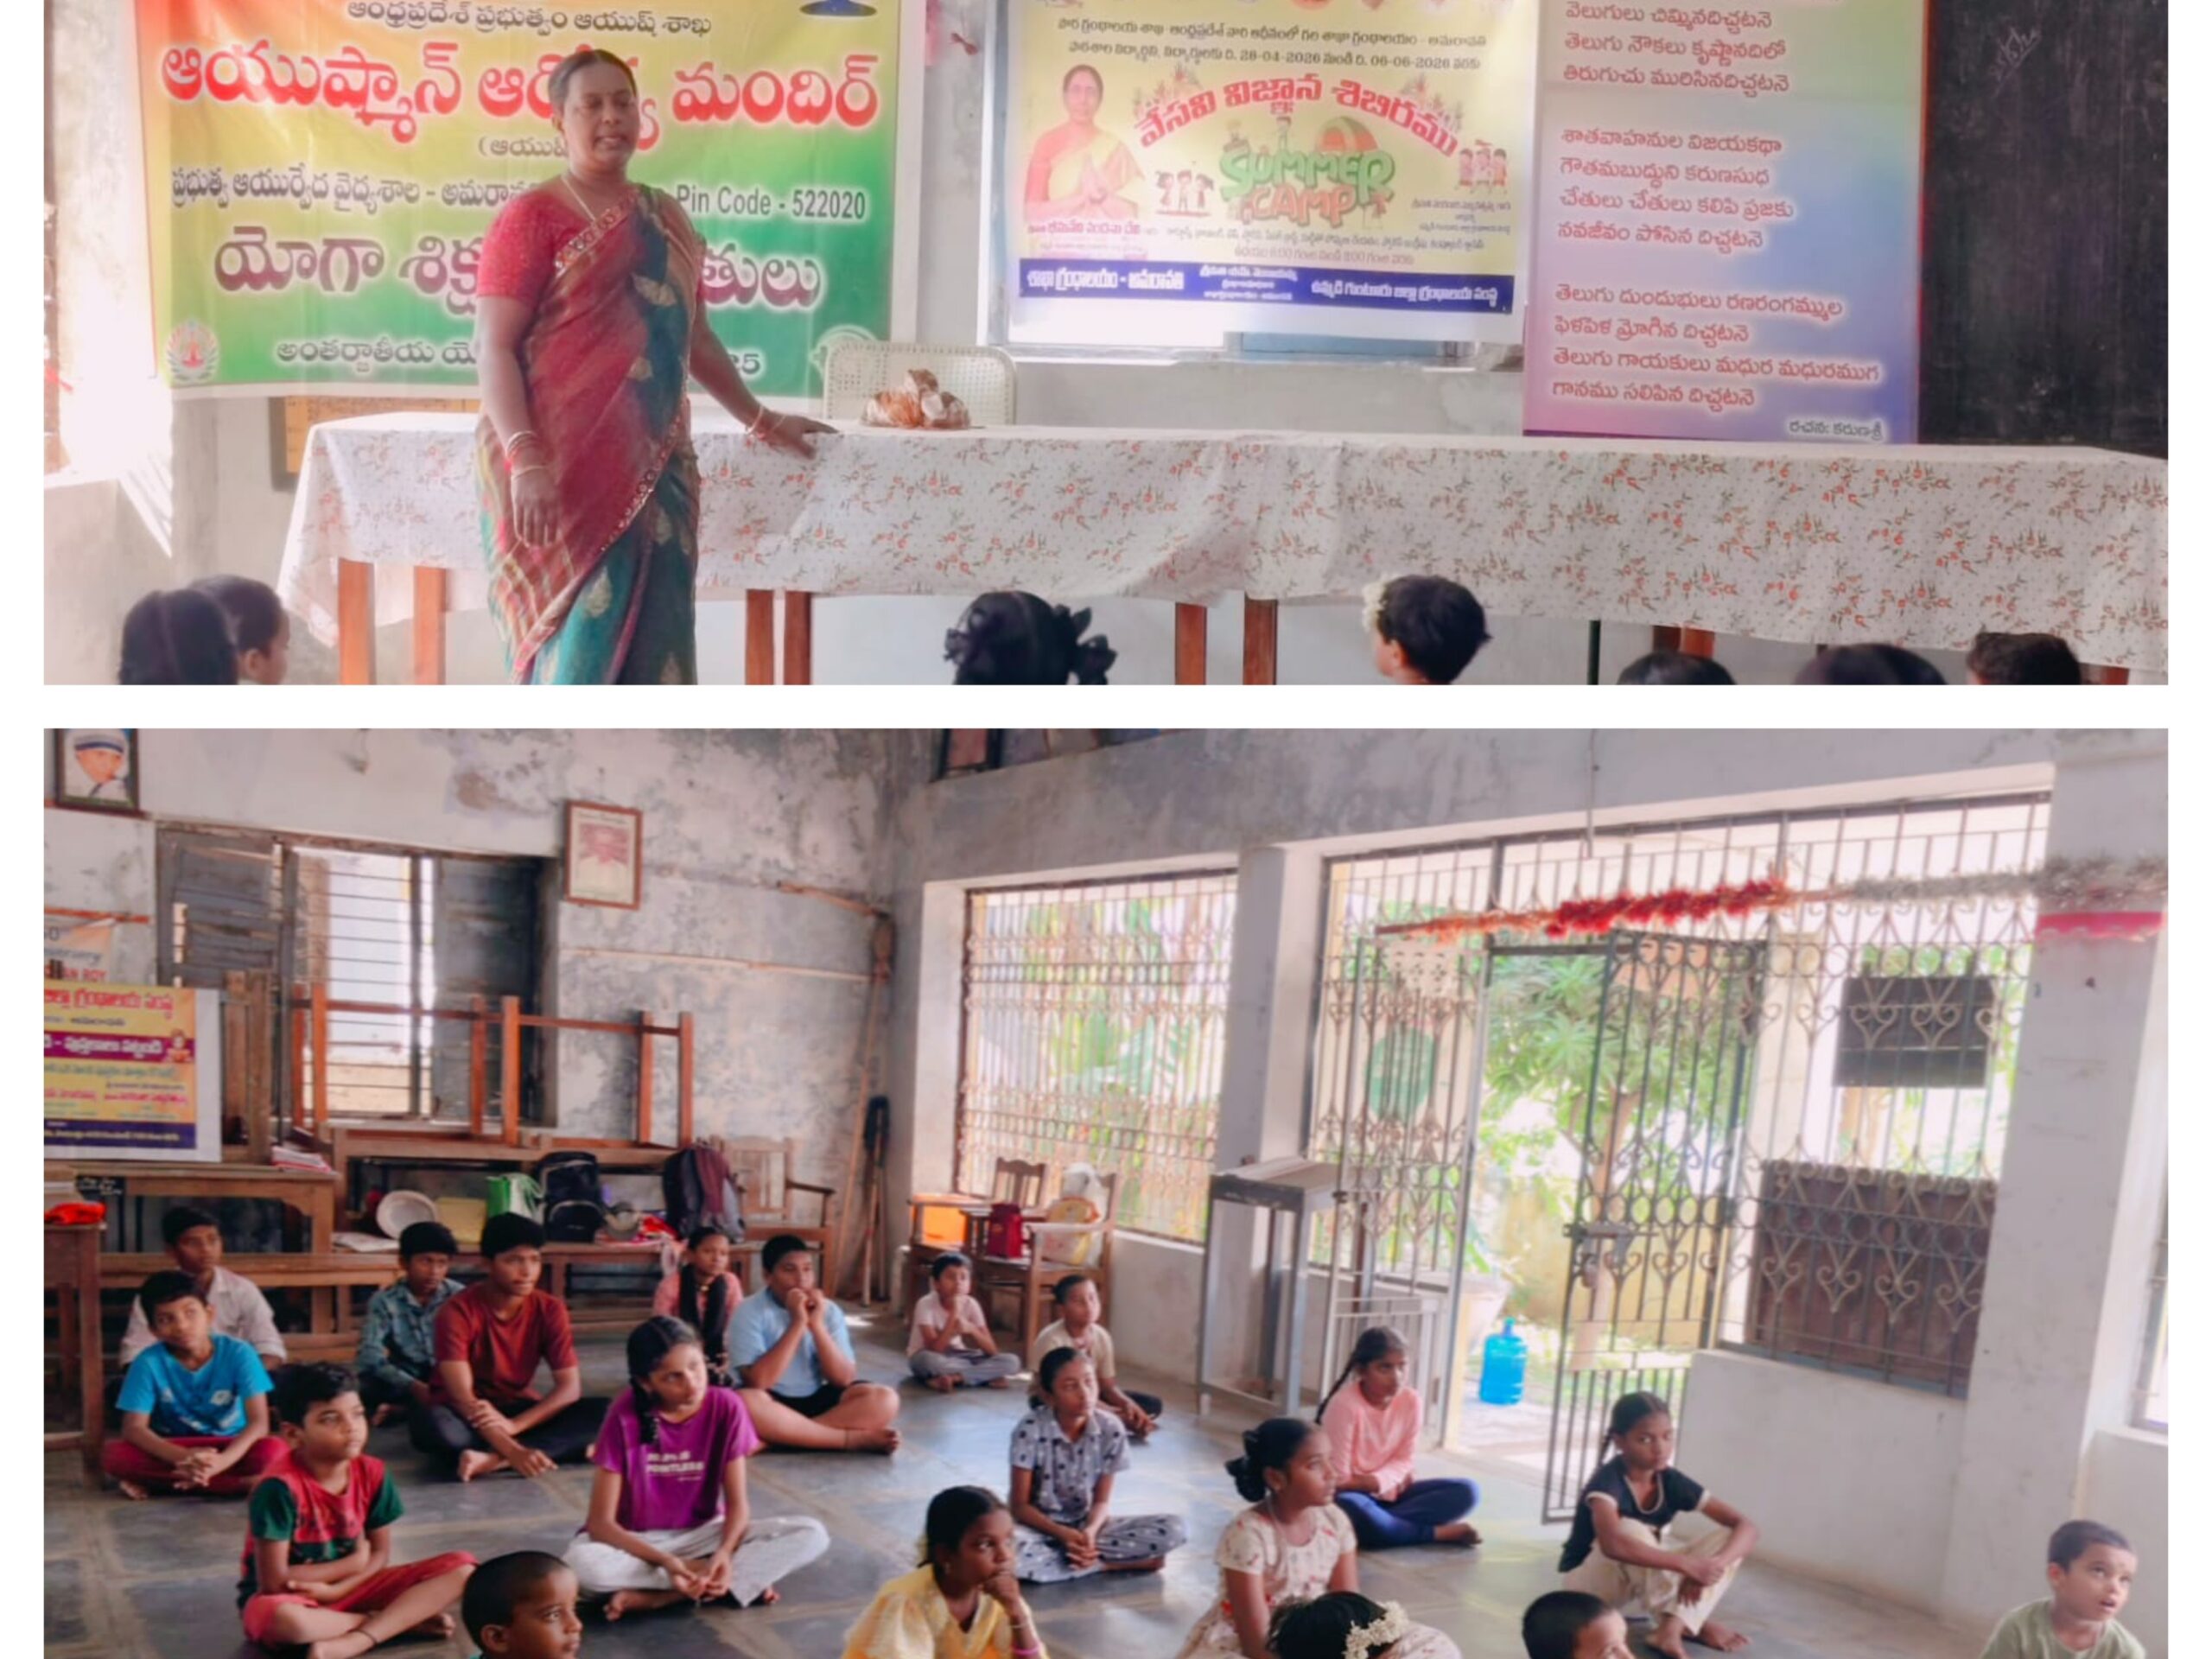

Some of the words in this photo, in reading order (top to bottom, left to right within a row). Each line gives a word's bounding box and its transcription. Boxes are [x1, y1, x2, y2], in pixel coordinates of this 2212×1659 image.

[476, 6, 568, 35] ప్రభుత్వం
[574, 10, 657, 37] ఆయుష్
[662, 13, 712, 37] శాఖ
[1565, 1, 1645, 22] వెలుగులు
[1565, 32, 1623, 52] తెలుగు
[1628, 35, 1686, 55] నౌకలు
[1563, 64, 1645, 85] తిరుగుచు
[162, 39, 461, 143] ఆయుష్మాన్
[672, 54, 880, 128] మందిర్
[1134, 90, 1217, 148] వేసవి
[1560, 128, 1683, 149] శాతవాహనుల
[172, 166, 229, 208] ప్రభుత్వ
[232, 162, 329, 208] ఆయుర్వేద
[334, 173, 421, 214] వైద్యశాల
[1219, 149, 1396, 207] SUMMER
[677, 184, 710, 213] Pin
[717, 186, 772, 215] Code
[792, 189, 866, 219] 522020
[1241, 183, 1358, 230] CAMP
[1560, 186, 1624, 209] చేతులు
[1629, 189, 1693, 213] చేతులు
[1697, 195, 1739, 216] కలిపి
[1743, 199, 1795, 221] ప్రజకు
[1558, 219, 1630, 241] నవజీవం
[1636, 222, 1693, 245] పోసిన
[215, 226, 385, 292] యోగా
[1554, 283, 1614, 303] తెలుగు
[1619, 289, 1721, 311] దుందుభులు
[276, 338, 435, 372] అంతర్జాతీయ
[1554, 347, 1613, 366] తెలుగు
[1618, 351, 1711, 373] గాయకులు
[1715, 356, 1773, 378] మధుర
[1552, 380, 1618, 399] గానము
[1623, 384, 1684, 404] సలిపిన
